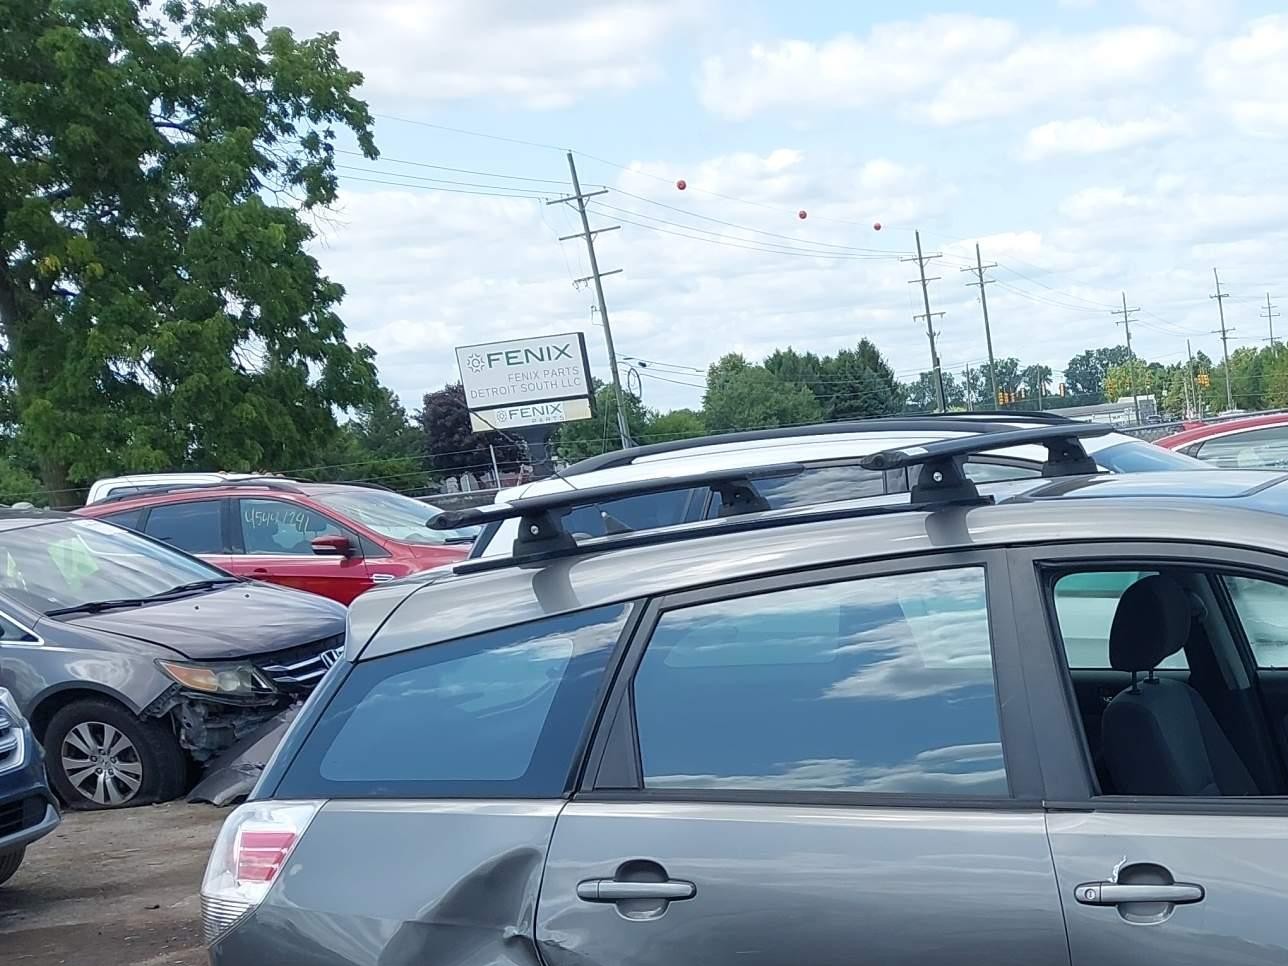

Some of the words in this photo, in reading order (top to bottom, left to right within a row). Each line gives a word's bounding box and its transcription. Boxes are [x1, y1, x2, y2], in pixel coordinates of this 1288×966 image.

[487, 344, 572, 368] FENIX
[508, 370, 540, 383] FENIX
[543, 367, 579, 376] PARTS
[471, 384, 516, 398] DETROIT
[521, 378, 557, 393] SOUTH
[562, 377, 581, 388] LLC
[509, 404, 562, 420] FENIX
